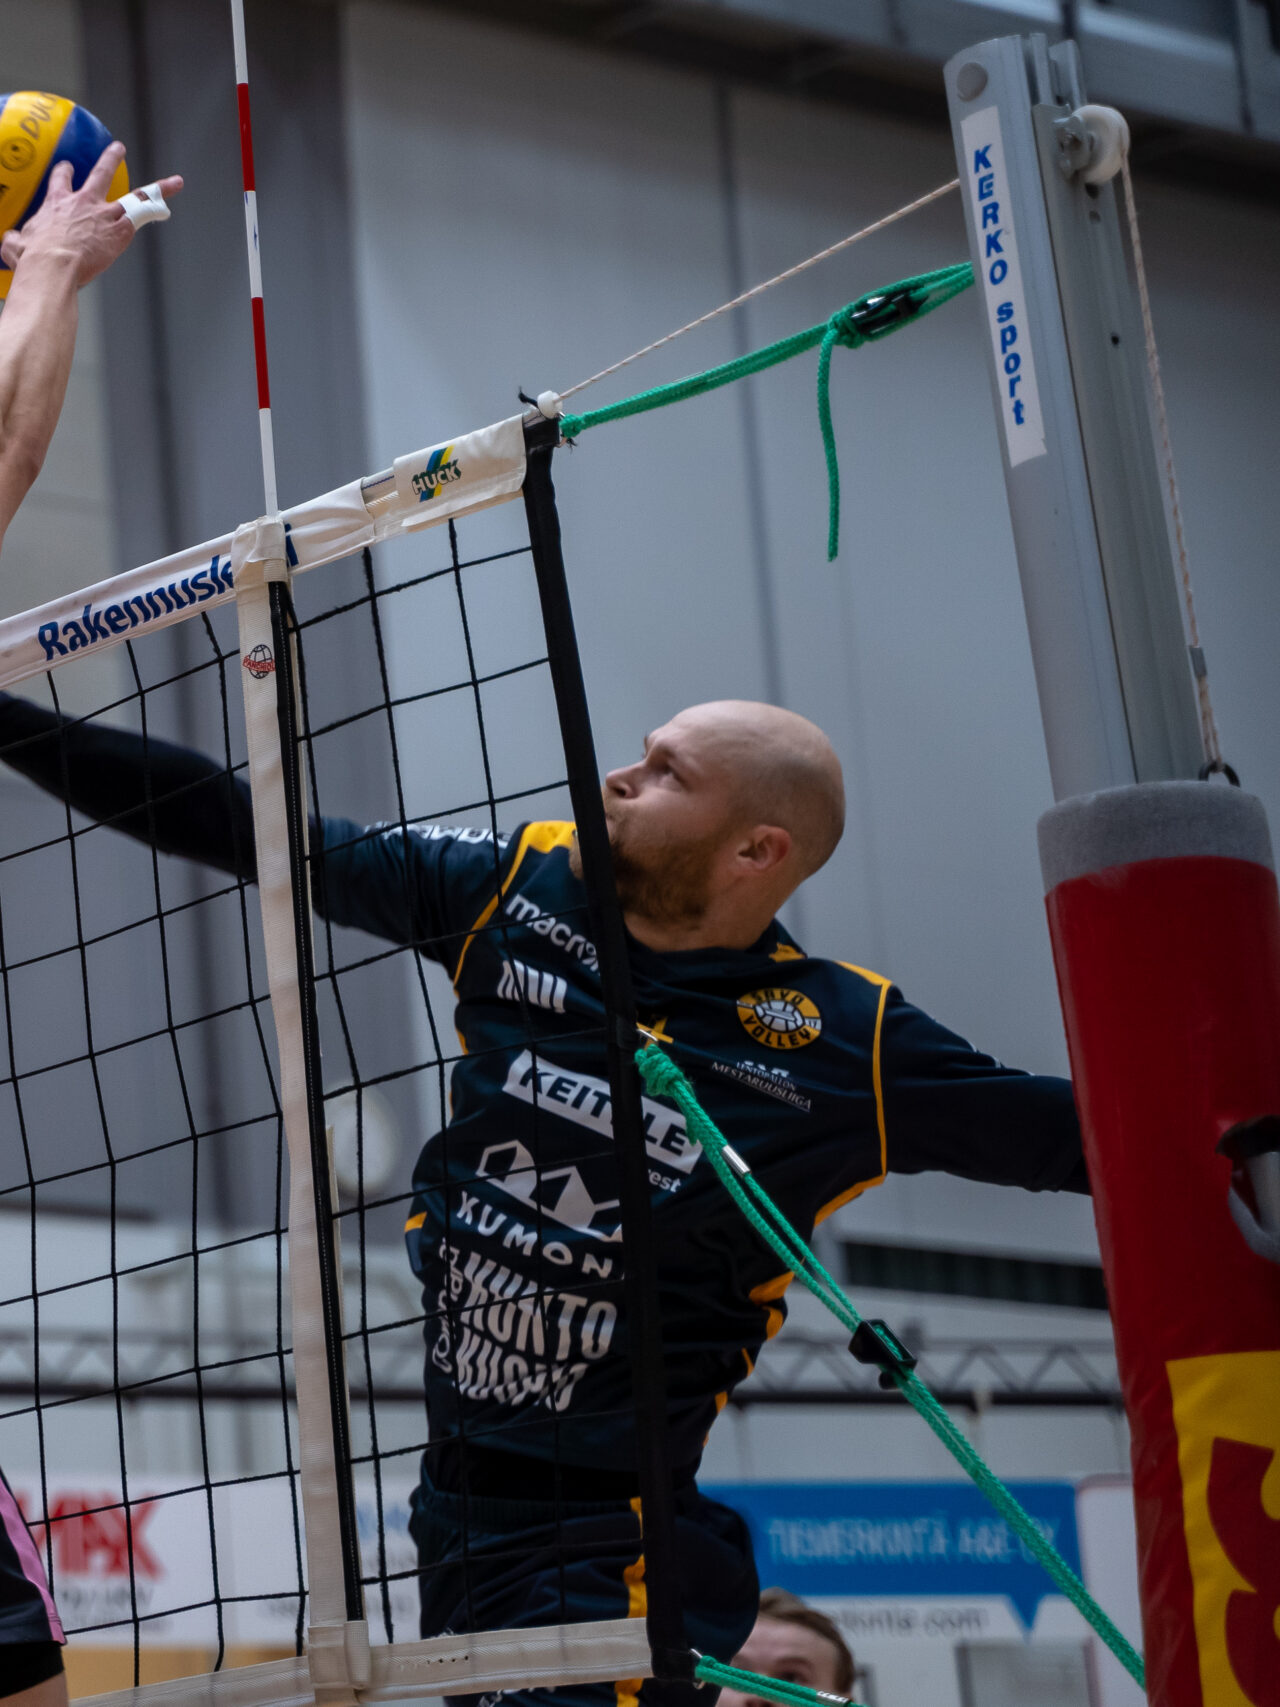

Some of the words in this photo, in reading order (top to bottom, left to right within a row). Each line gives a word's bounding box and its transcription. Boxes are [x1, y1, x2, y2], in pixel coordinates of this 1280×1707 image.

[974, 144, 1009, 286] KERKO
[411, 459, 462, 495] HUCK
[744, 1015, 811, 1047] VOLLEY
[520, 1067, 686, 1157] KEITLE
[460, 1251, 618, 1361] KUNTO
